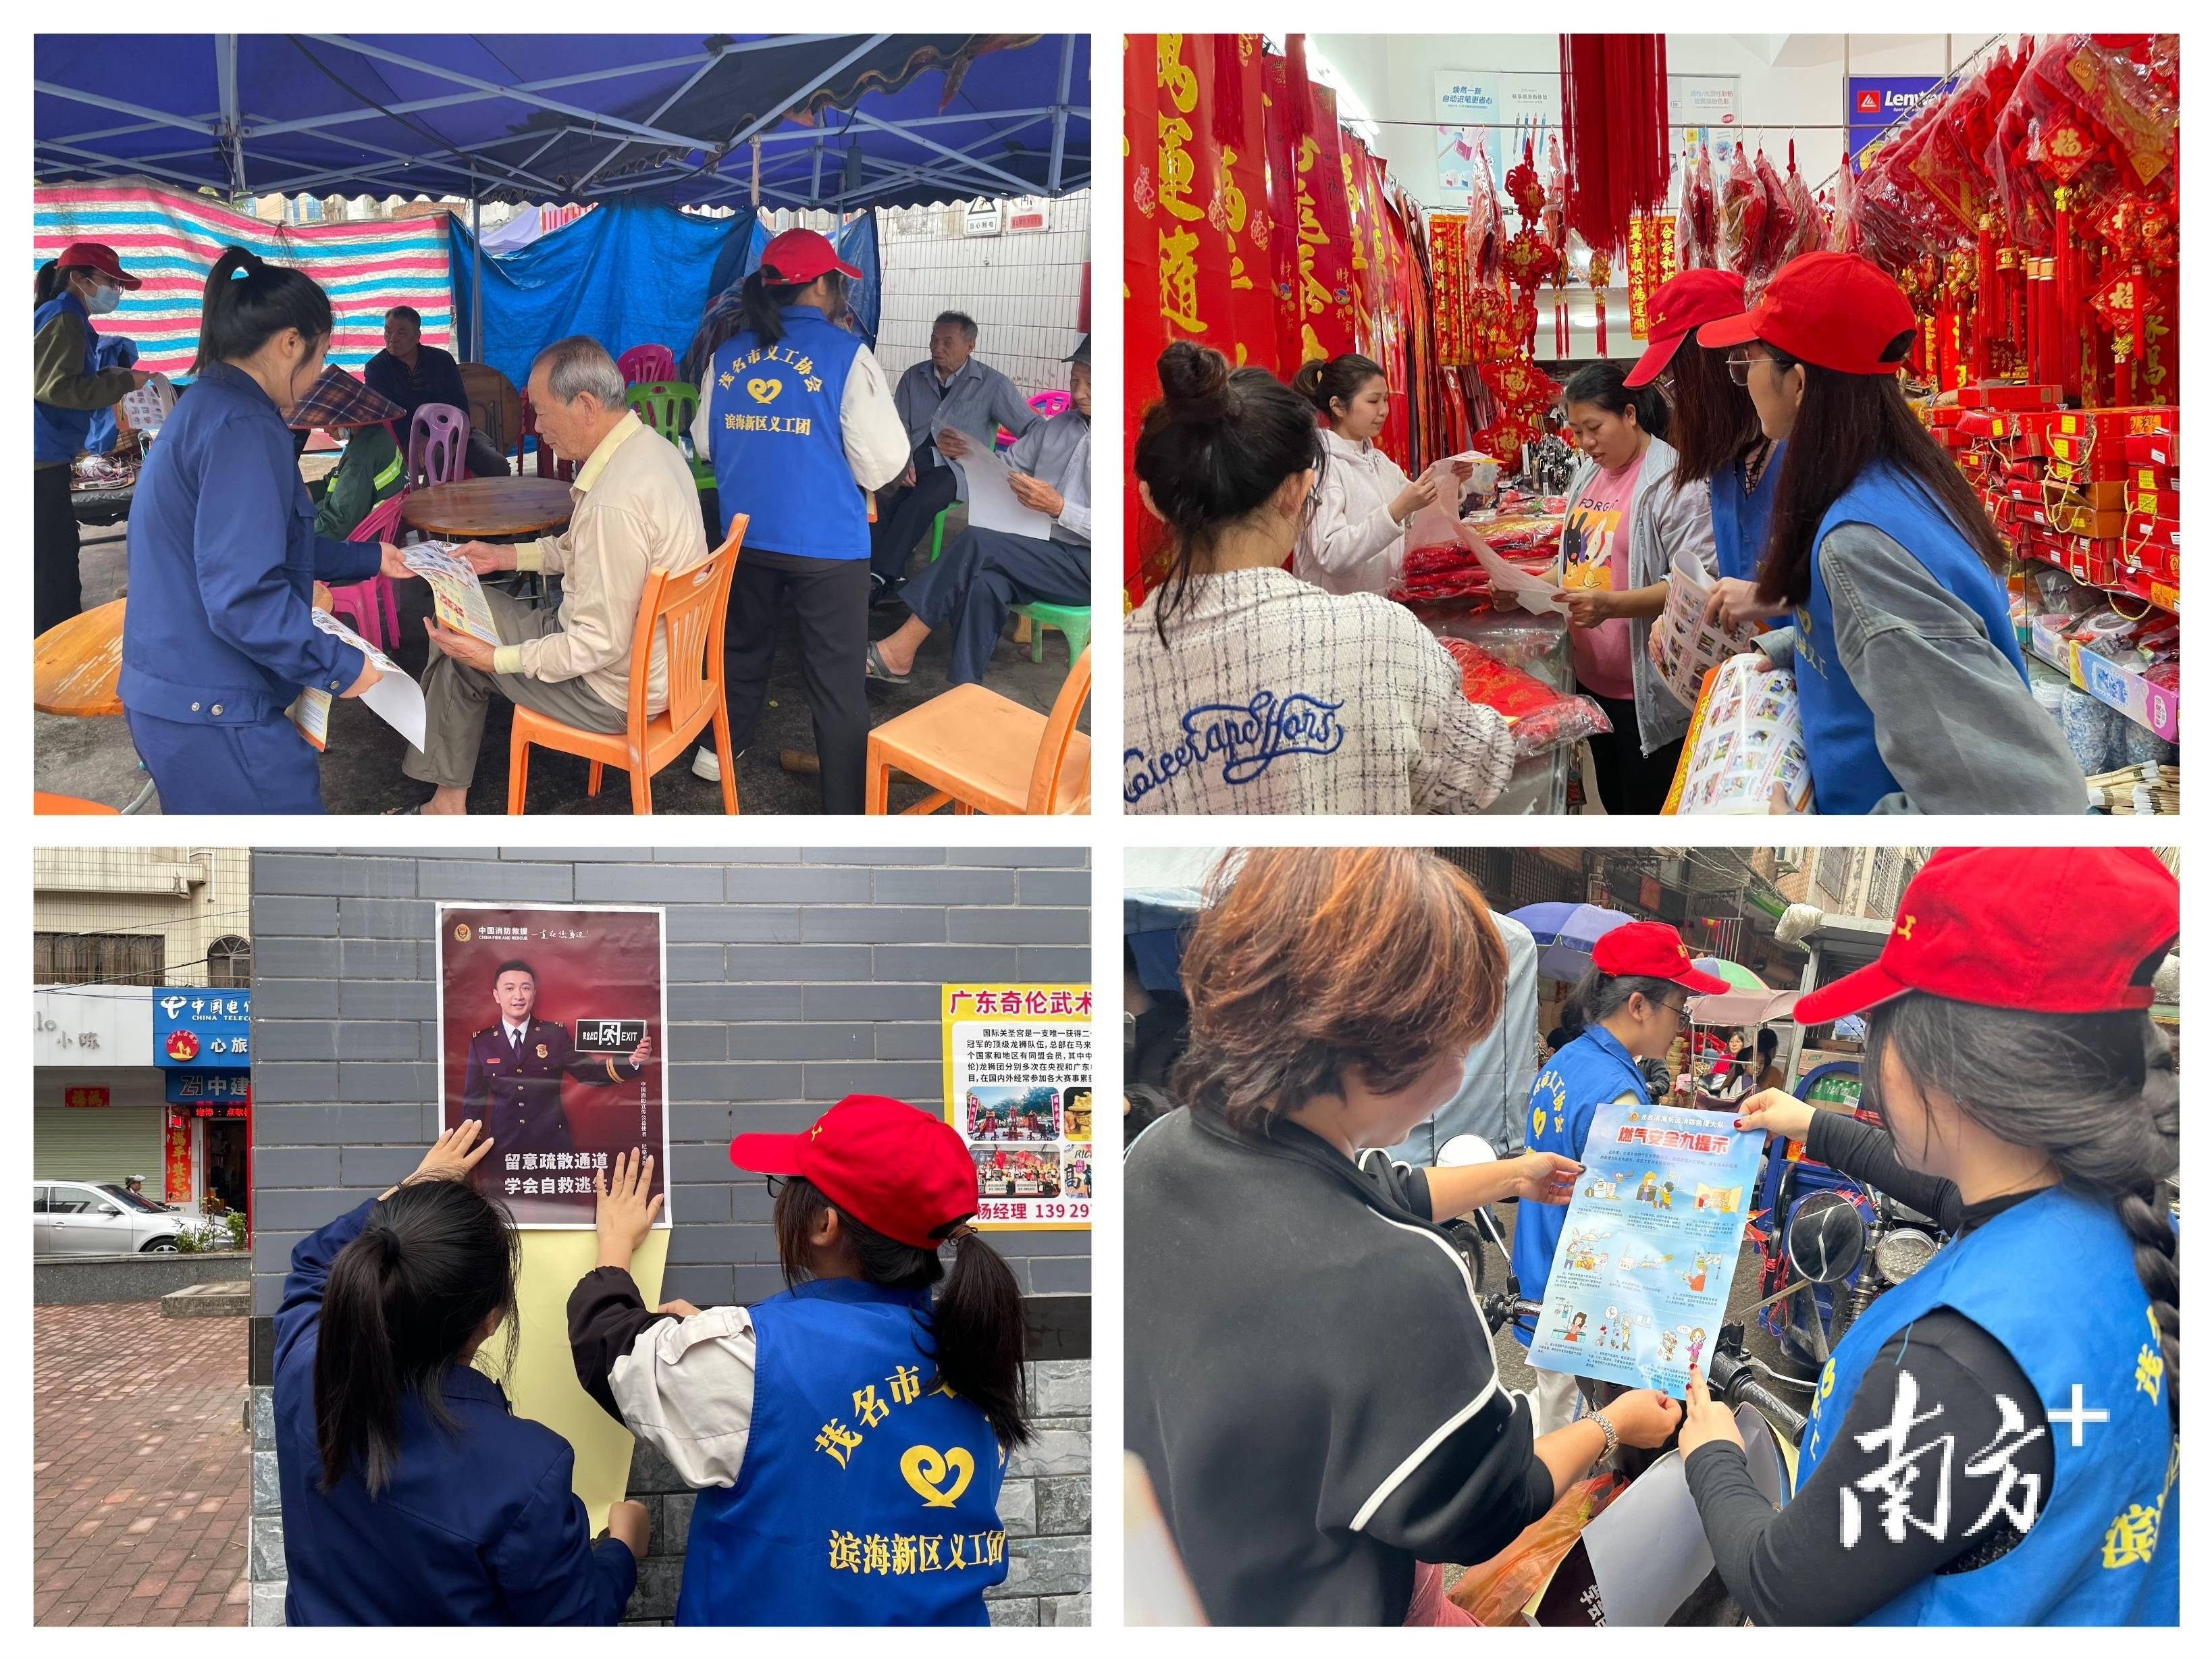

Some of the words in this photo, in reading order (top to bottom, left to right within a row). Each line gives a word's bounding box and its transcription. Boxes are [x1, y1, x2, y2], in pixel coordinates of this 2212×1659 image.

[1452, 86, 1481, 95] 焕然一新
[1442, 95, 1493, 104] 自动进笔更省心
[2051, 128, 2082, 157] 福
[970, 221, 994, 230] 当心触电
[718, 345, 822, 392] 茂名市义工协会
[725, 413, 811, 436] 滨海新区义工团
[583, 1032, 598, 1041] 安全出口
[621, 1032, 637, 1042] EXIT
[983, 1029, 1092, 1037] 国际关圣宫是一支唯一获得二
[211, 1038, 248, 1053] 心旅
[968, 1063, 1092, 1072] 伦)龙狮团分别多次在央视和广东
[1616, 1126, 1730, 1154] 燃气安全九提示
[505, 1152, 608, 1170] 留意疏散通道
[829, 1529, 1005, 1575] 滨海新区义工团
